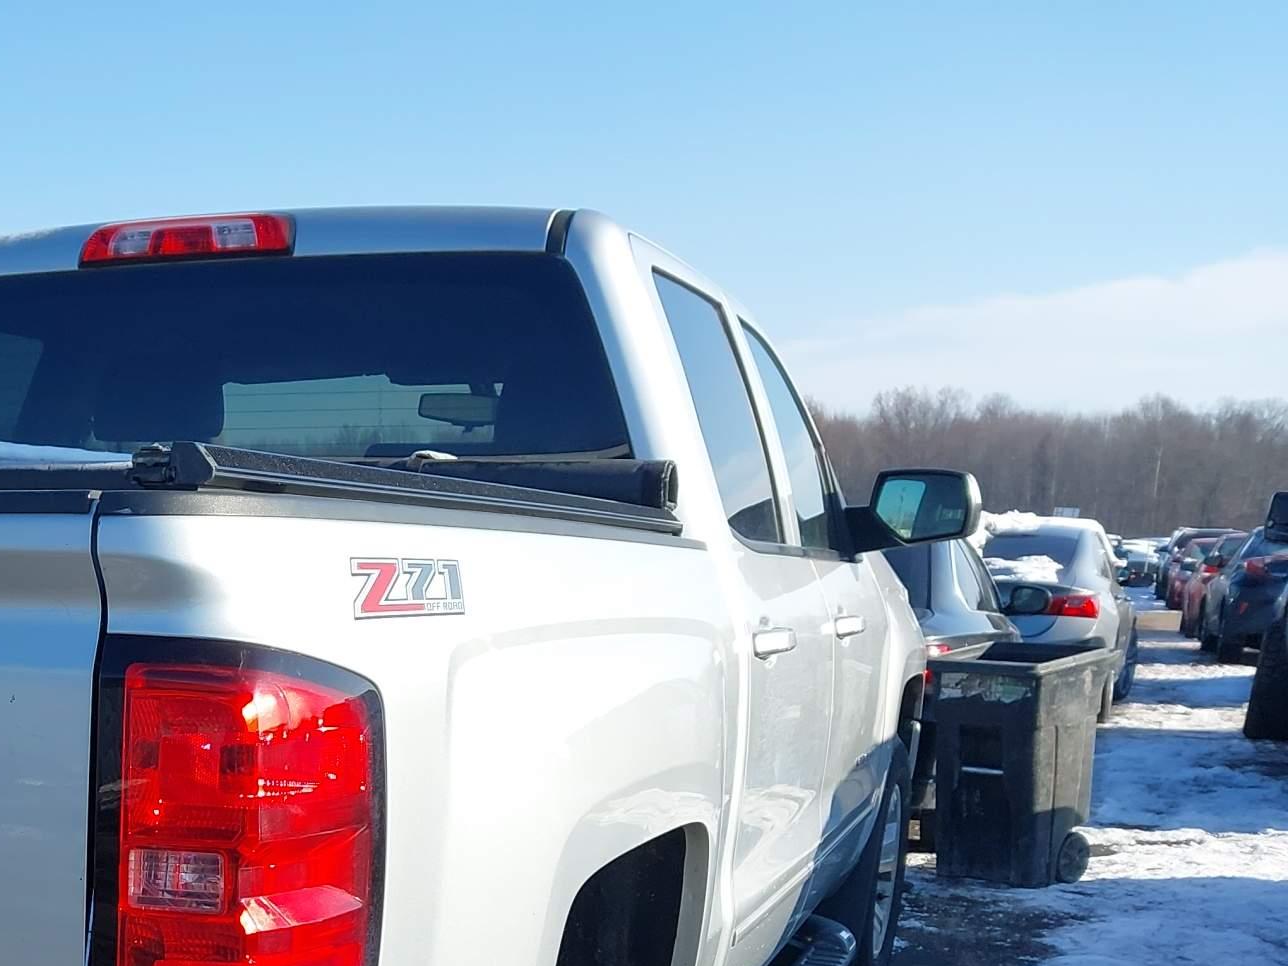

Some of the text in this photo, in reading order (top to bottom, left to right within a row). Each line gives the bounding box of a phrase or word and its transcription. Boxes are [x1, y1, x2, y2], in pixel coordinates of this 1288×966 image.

[350, 557, 464, 620] Z71
[426, 601, 463, 611] OFF ROAD
